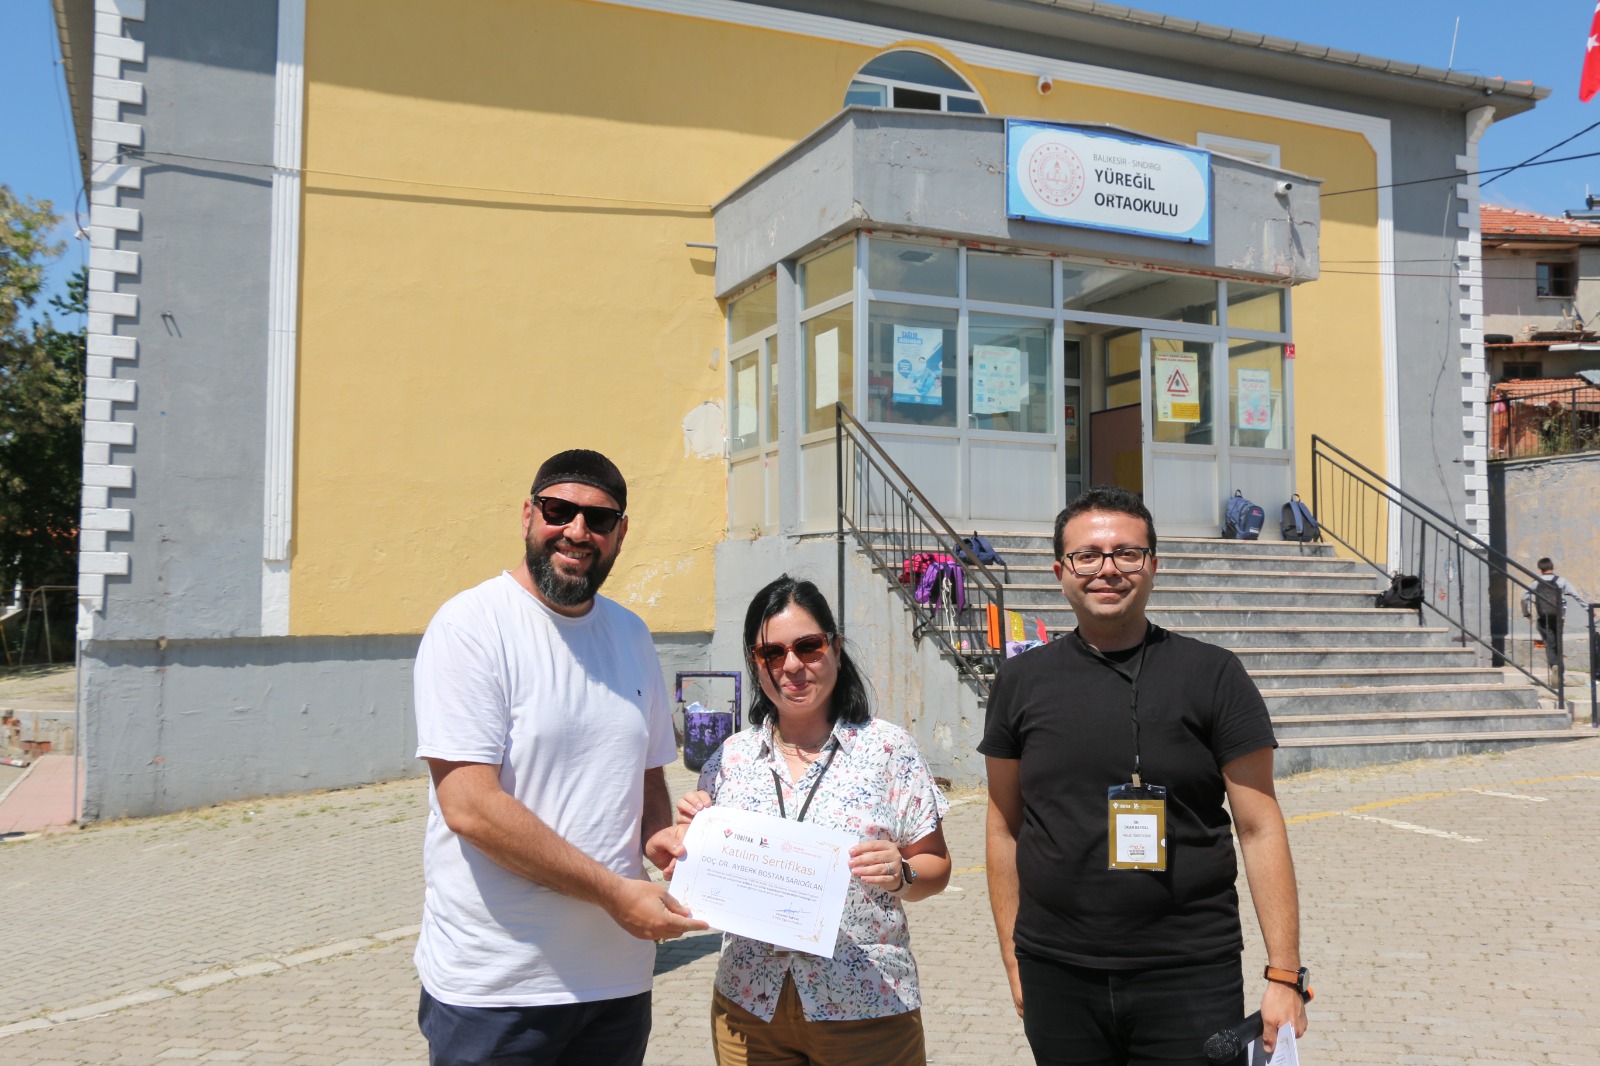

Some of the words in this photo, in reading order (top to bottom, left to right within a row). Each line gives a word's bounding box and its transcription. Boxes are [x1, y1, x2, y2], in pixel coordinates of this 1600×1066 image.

[1093, 153, 1127, 165] BALIKESİR
[1094, 167, 1156, 191] YÜREĞİL
[1094, 192, 1178, 217] ORTAOKULU
[721, 845, 759, 862] Katılım
[761, 854, 816, 877] Sertifikası
[731, 863, 758, 875] AYBERK
[758, 869, 785, 882] BOSTAN
